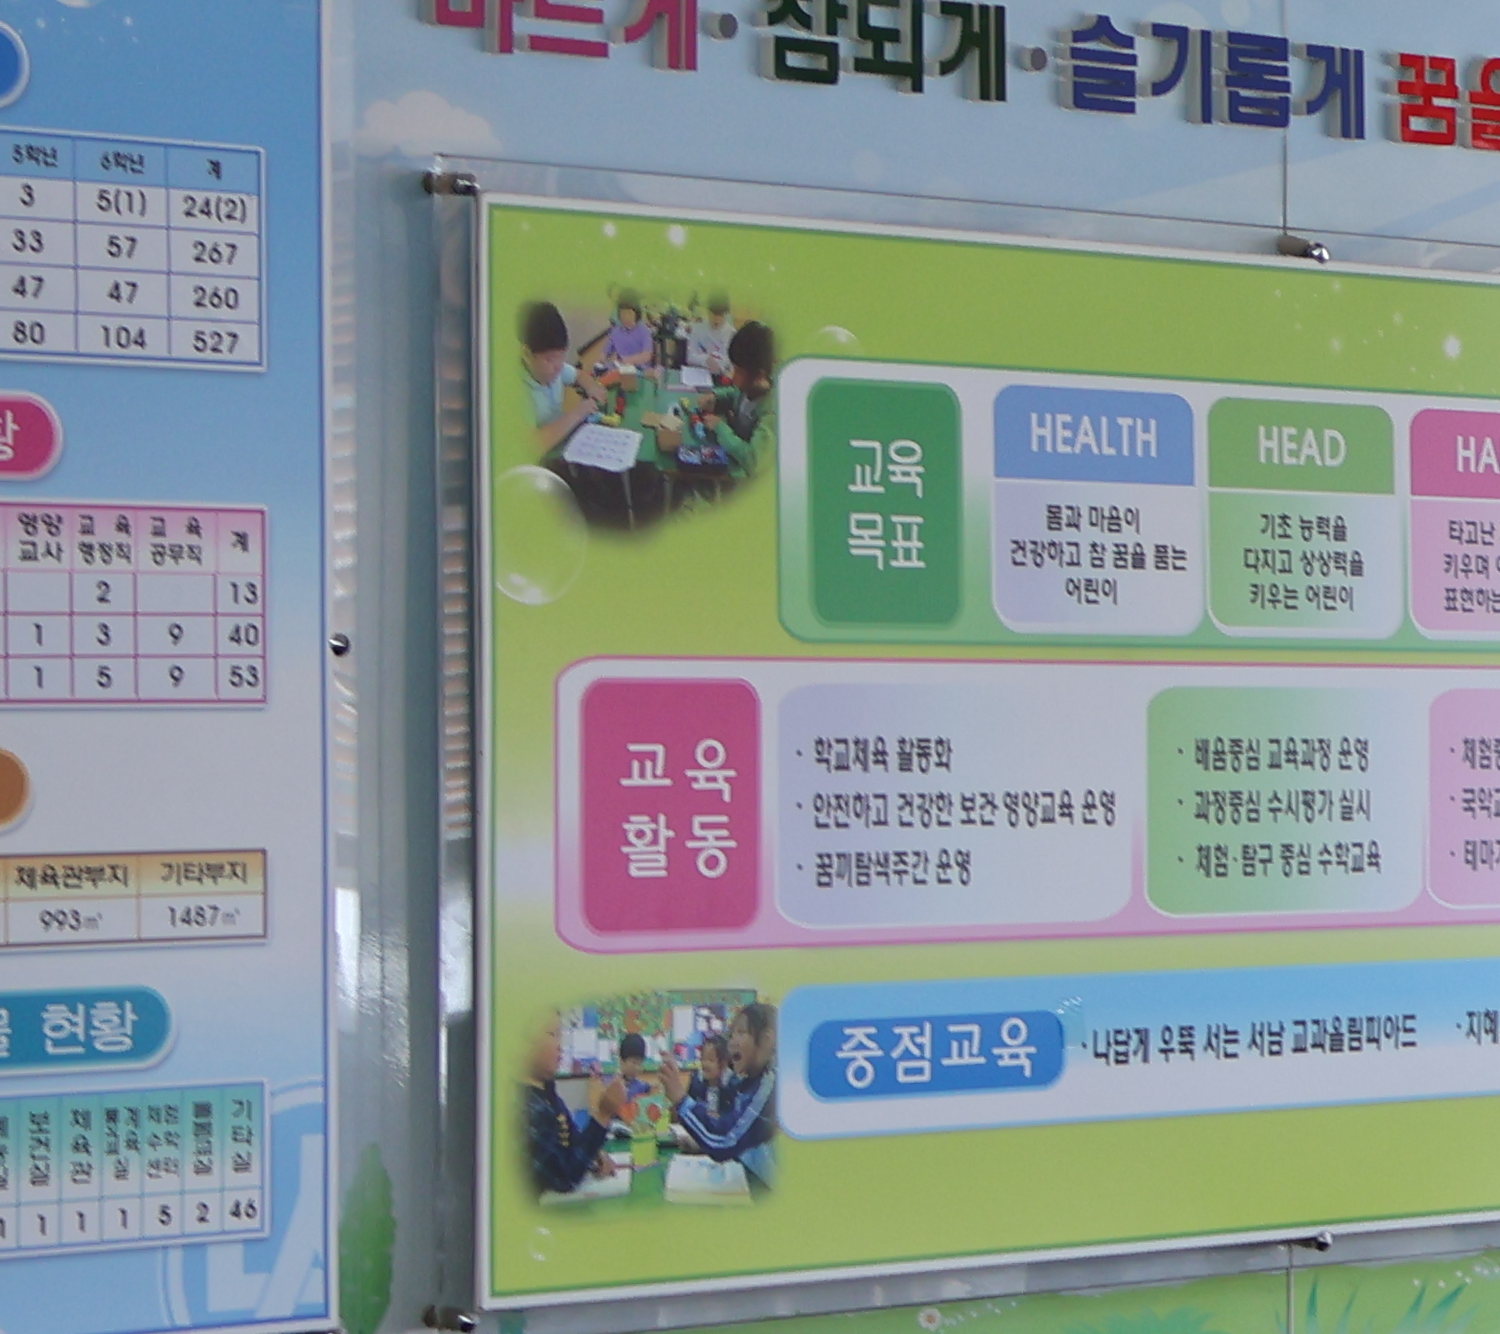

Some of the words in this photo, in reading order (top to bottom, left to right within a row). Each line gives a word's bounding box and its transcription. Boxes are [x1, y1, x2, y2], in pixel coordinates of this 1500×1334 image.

[12, 143, 58, 168] 5학년
[101, 151, 145, 174] 6학년
[19, 183, 35, 207] 3
[96, 189, 147, 217] 5(1)
[183, 195, 247, 224] 24(2)
[11, 229, 44, 253] 33
[106, 235, 138, 260] 57
[192, 240, 238, 265] 267
[11, 275, 44, 299] 47
[106, 280, 139, 305] 47
[192, 285, 239, 310] 260
[12, 321, 45, 345] 80
[100, 325, 147, 349] 104
[192, 330, 239, 354] 527
[1029, 412, 1158, 459] HEALTH
[1257, 425, 1348, 468] HEAD
[848, 438, 926, 499] 교육
[1044, 503, 1083, 534] 몸과
[1088, 505, 1141, 535] 마음이
[1260, 512, 1293, 542] 기초
[1299, 514, 1348, 543] 능력을
[1449, 519, 1495, 547] 타고난
[18, 539, 64, 564] 교사
[848, 511, 926, 571] 목표
[1010, 538, 1082, 571] 건강하고
[1088, 540, 1107, 569] 참
[1112, 542, 1147, 571] 꿈을
[1153, 543, 1188, 572] 품는
[1243, 547, 1294, 576] 다지고
[1299, 549, 1364, 578] 상상력을
[1443, 553, 1490, 581] 키우며
[96, 580, 111, 604] 2
[229, 580, 259, 605] 13
[1065, 577, 1118, 606] 어린이
[1249, 583, 1299, 611] 키우는
[1305, 584, 1355, 612] 어린이
[33, 622, 43, 647] 1
[96, 622, 112, 647] 3
[168, 622, 184, 646] 9
[228, 622, 259, 647] 40
[33, 665, 43, 689] 1
[95, 664, 112, 689] 5
[168, 664, 184, 688] 9
[228, 664, 260, 689] 53
[618, 737, 738, 802] 교육
[814, 735, 889, 773] 학교체육
[1194, 736, 1260, 771] 배움중심
[1267, 736, 1331, 771] 교육과정
[1338, 736, 1369, 772] 운영
[813, 791, 889, 829] 안전하고
[896, 791, 953, 828] 건강한
[960, 789, 999, 827] 보건
[1003, 789, 1075, 827] 영양교육
[1081, 788, 1117, 827] 운영
[1194, 789, 1261, 825] 과정중심
[1267, 789, 1333, 824] 수시평가
[1339, 788, 1371, 822] 실시
[619, 812, 738, 880] 활동
[1280, 842, 1311, 878] 중심
[1318, 839, 1381, 875] 수학교육
[935, 848, 972, 886] 운영
[41, 1000, 139, 1055] 현황
[835, 1016, 1038, 1089] 중점교육
[1091, 1027, 1151, 1066] 나답게
[1157, 1023, 1196, 1062] 우뚝
[1203, 1022, 1240, 1060] 서는
[1247, 1019, 1285, 1057] 서남
[1291, 1013, 1418, 1055] 교과올림피아드
[158, 1204, 172, 1226] 5
[196, 1201, 210, 1224] 2
[229, 1198, 258, 1220] 46
